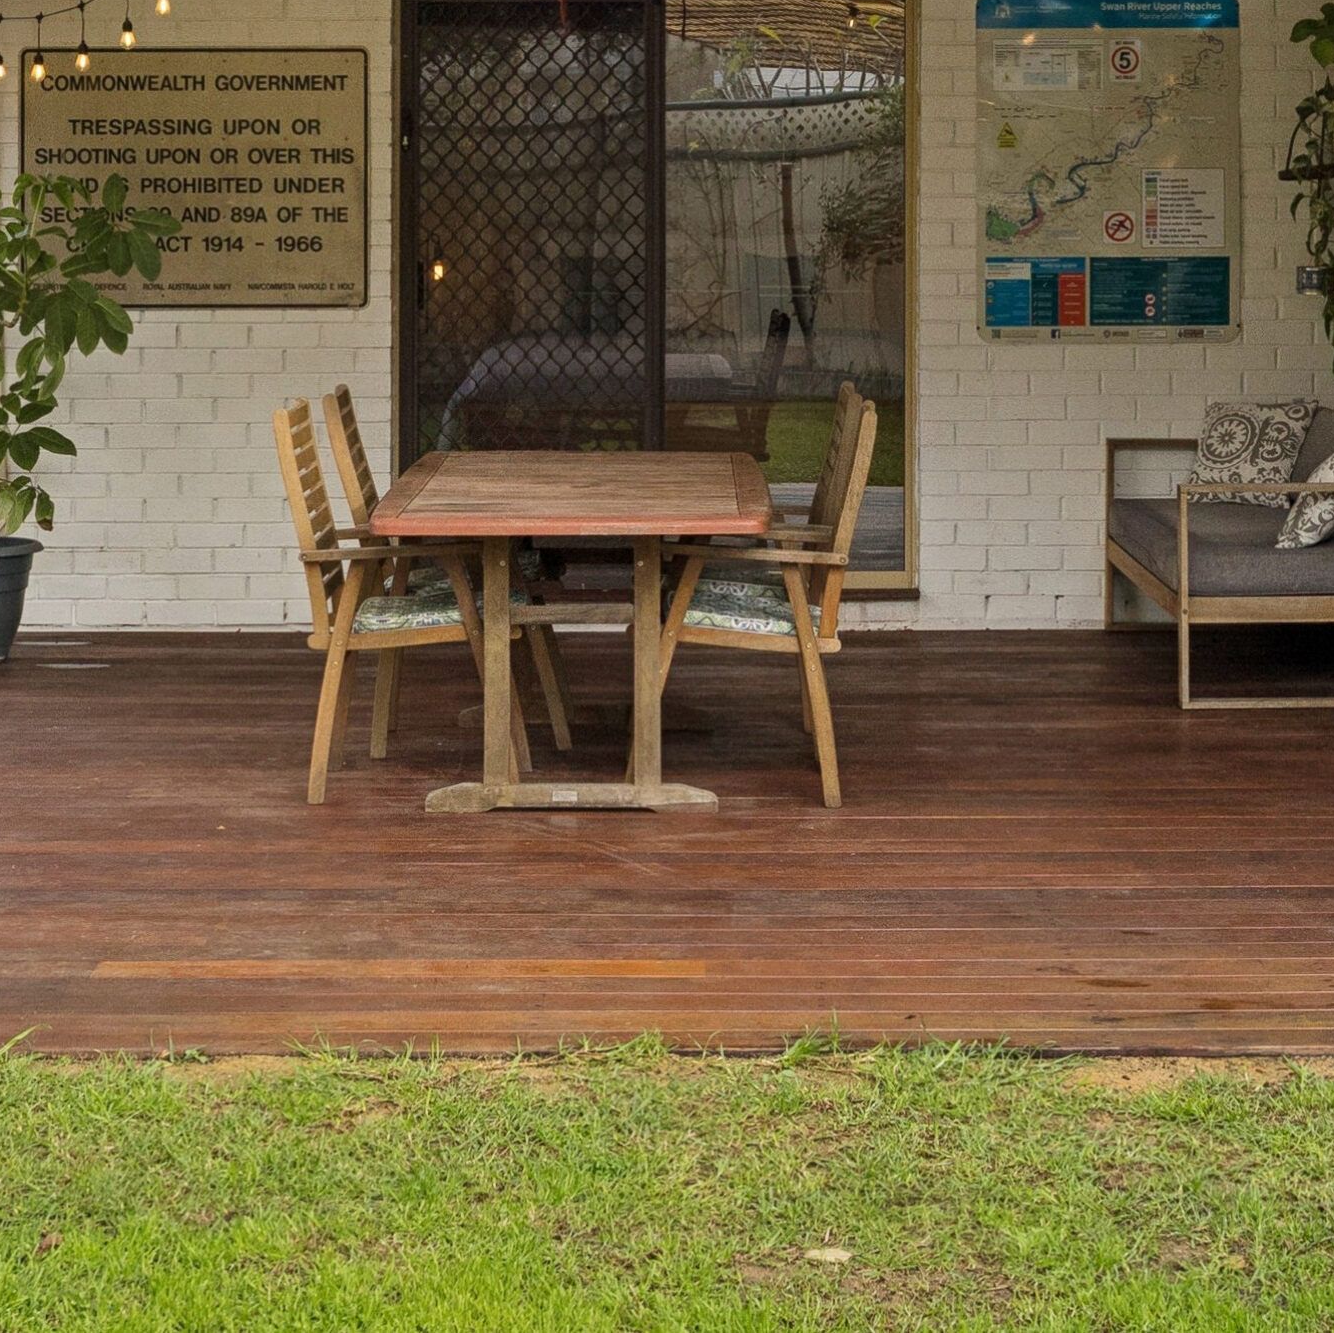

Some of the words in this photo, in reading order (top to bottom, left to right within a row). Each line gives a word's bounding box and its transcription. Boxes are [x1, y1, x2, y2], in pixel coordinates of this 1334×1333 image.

[1100, 2, 1126, 11] Swan
[1127, 2, 1152, 11] River
[1153, 2, 1181, 13] Upper
[1183, 2, 1222, 11] Reaches
[1119, 52, 1131, 69] 5
[40, 75, 205, 92] COMMONWEALTH
[215, 75, 348, 92] GOVERNMENT
[69, 119, 212, 135] TRESPASSING
[223, 119, 280, 135] UPON
[291, 119, 321, 135] OR
[34, 148, 136, 164] SHOOTING
[146, 148, 200, 164] UPON
[210, 148, 238, 164] OR
[248, 148, 300, 164] OVER
[310, 148, 354, 164] THIS
[44, 177, 99, 194] LD
[140, 177, 263, 194] PROHIBITED
[274, 177, 344, 194] UNDER
[40, 207, 137, 223] SECNS
[180, 207, 220, 223] AND
[230, 207, 267, 223] 89A
[277, 207, 303, 223] OF
[312, 207, 348, 223] THE
[156, 236, 192, 252] ACT
[202, 236, 244, 252] 1914
[275, 236, 323, 252] 1966
[94, 283, 127, 291] DEFENCE
[142, 283, 165, 291] ROYAL
[168, 283, 210, 291] AUSTRALIAN
[213, 283, 232, 291] NAVY
[297, 283, 327, 291] HAROLD
[337, 283, 355, 291] HOLT
